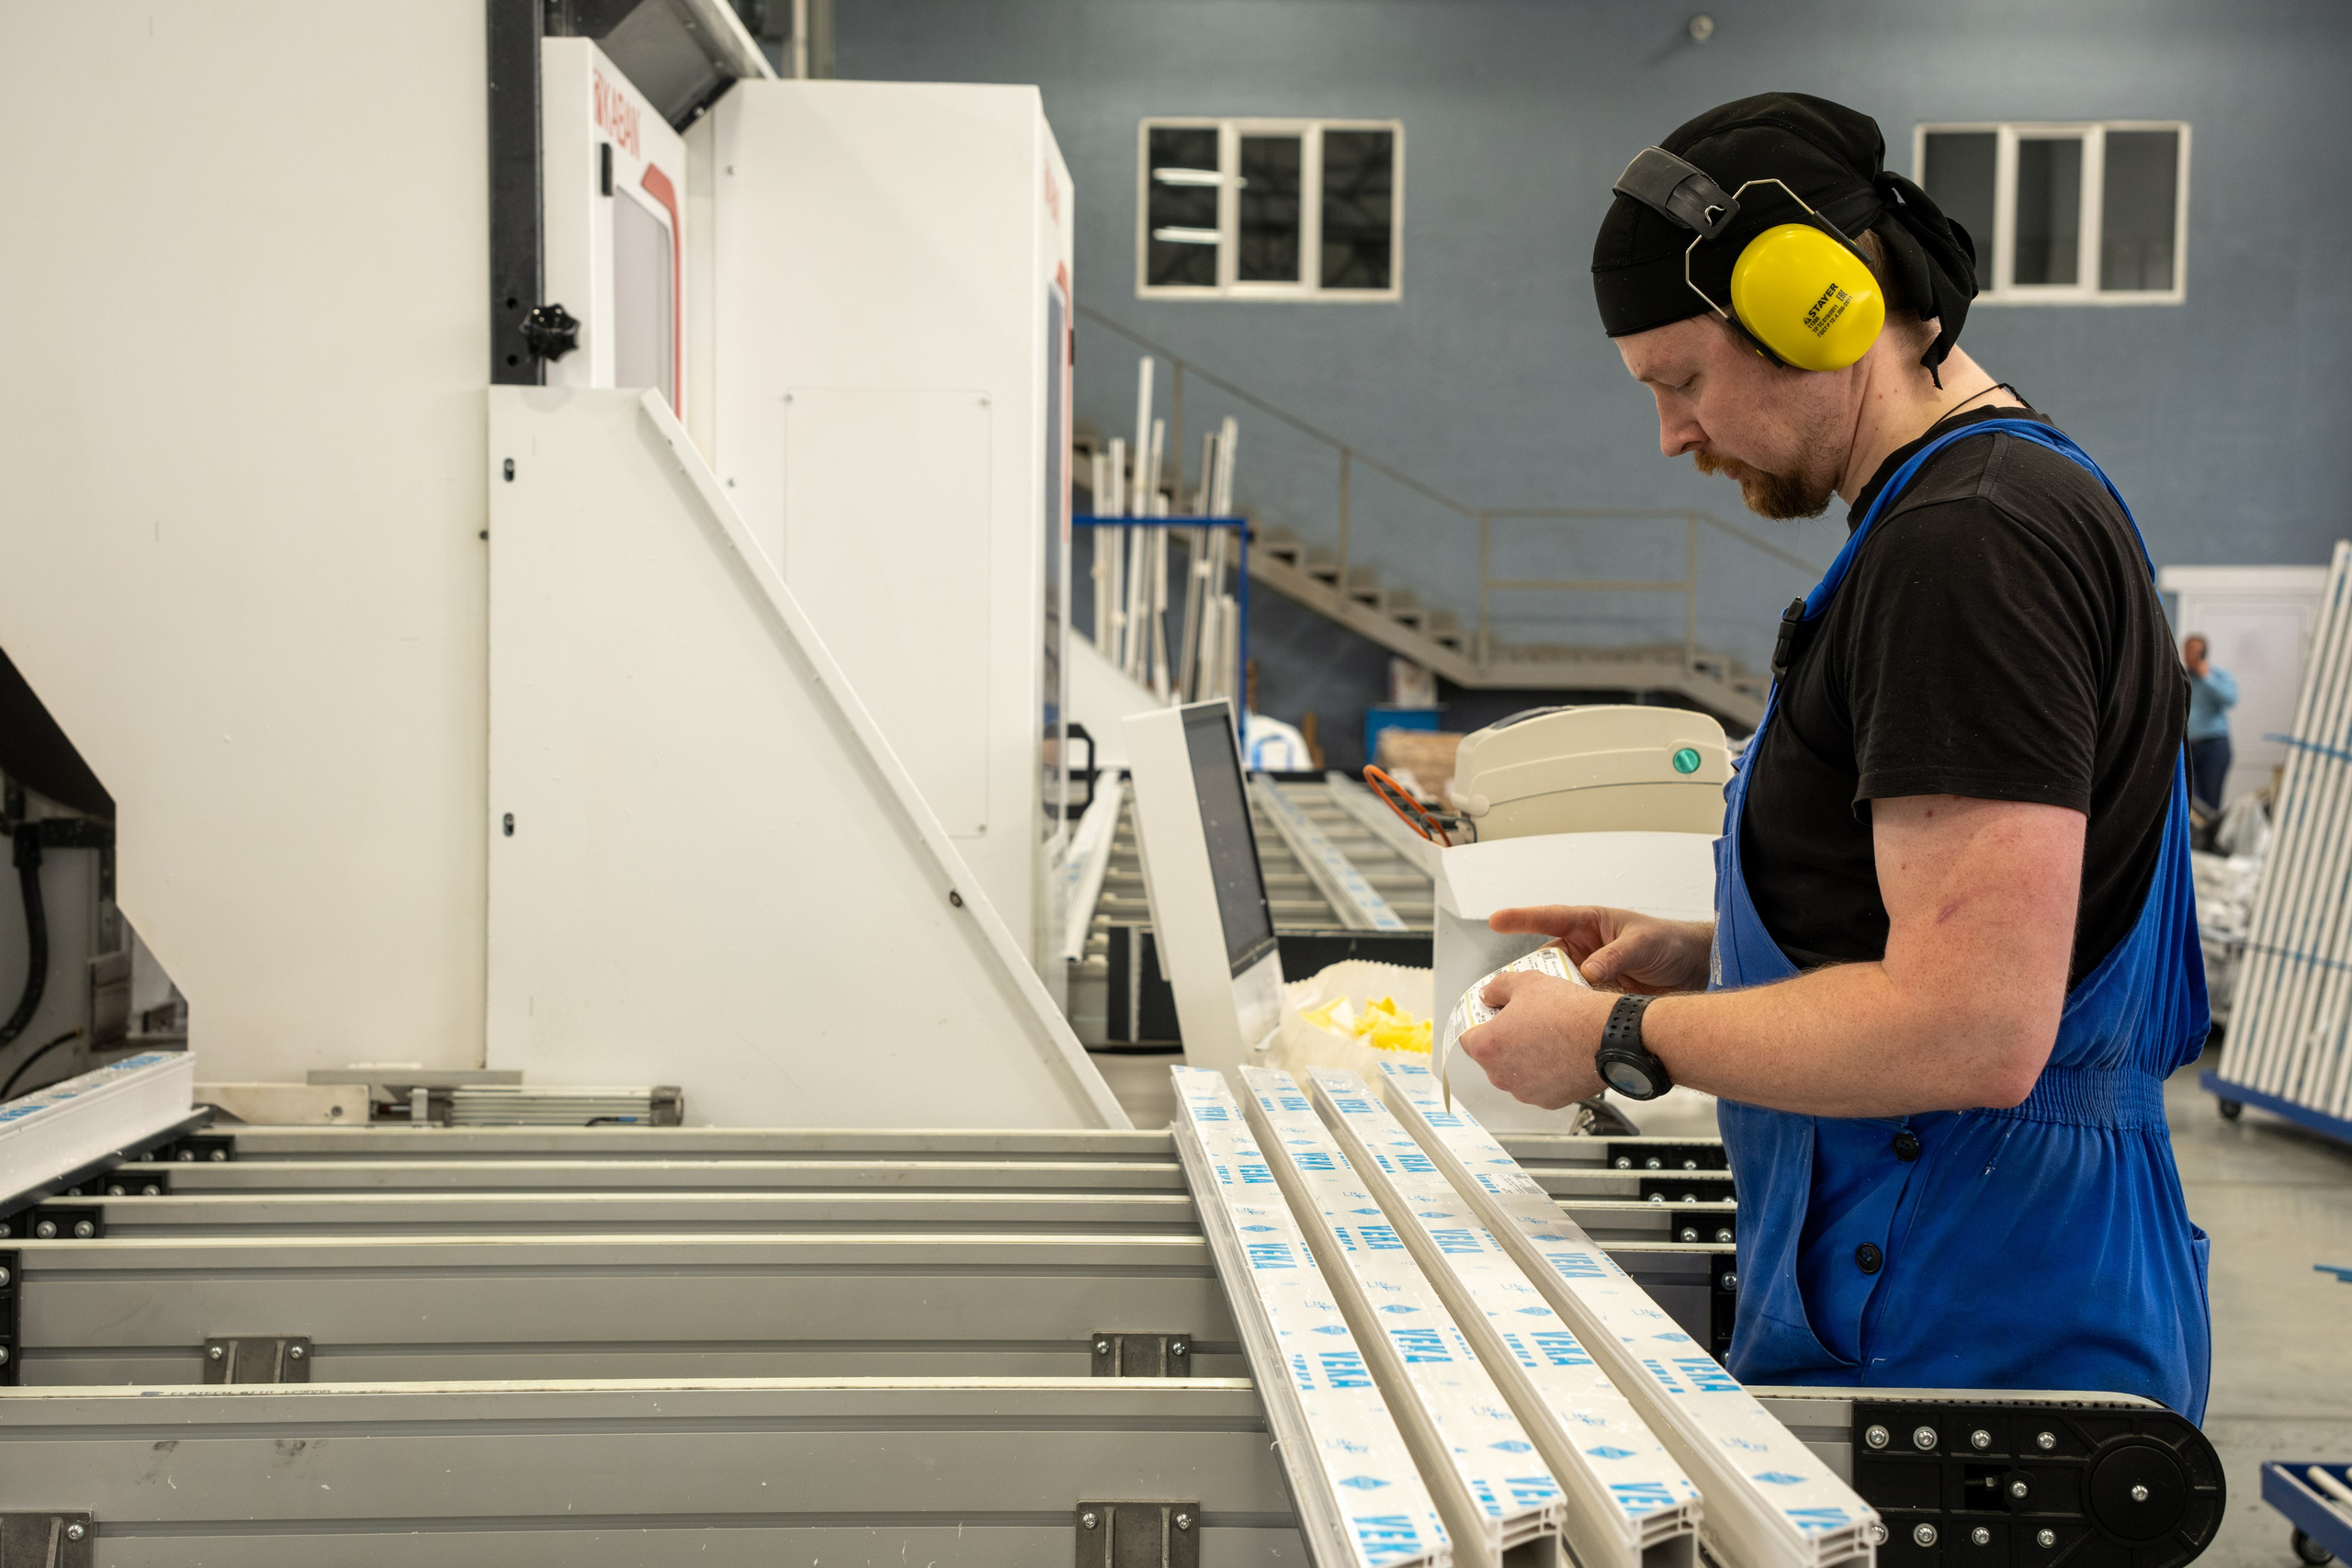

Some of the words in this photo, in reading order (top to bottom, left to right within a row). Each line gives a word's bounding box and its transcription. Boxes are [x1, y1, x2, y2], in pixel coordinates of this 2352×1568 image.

[1808, 283, 1838, 319] STAYER
[1193, 1107, 1229, 1121] VEKA
[1278, 1097, 1311, 1111] VEKA
[1335, 1100, 1373, 1113] VEKA
[1238, 1165, 1274, 1183] VEKA
[1293, 1153, 1336, 1171] VEKA
[1396, 1154, 1437, 1173] VEKA
[1358, 1225, 1405, 1249] VEKA
[1430, 1228, 1485, 1254] VEKA
[1247, 1243, 1297, 1269] VEKA
[1545, 1252, 1608, 1278] VEKA
[1390, 1328, 1453, 1363] VEKA
[1531, 1331, 1594, 1366] VEKA
[1318, 1351, 1373, 1388] VEKA
[1672, 1358, 1742, 1393] VEKA
